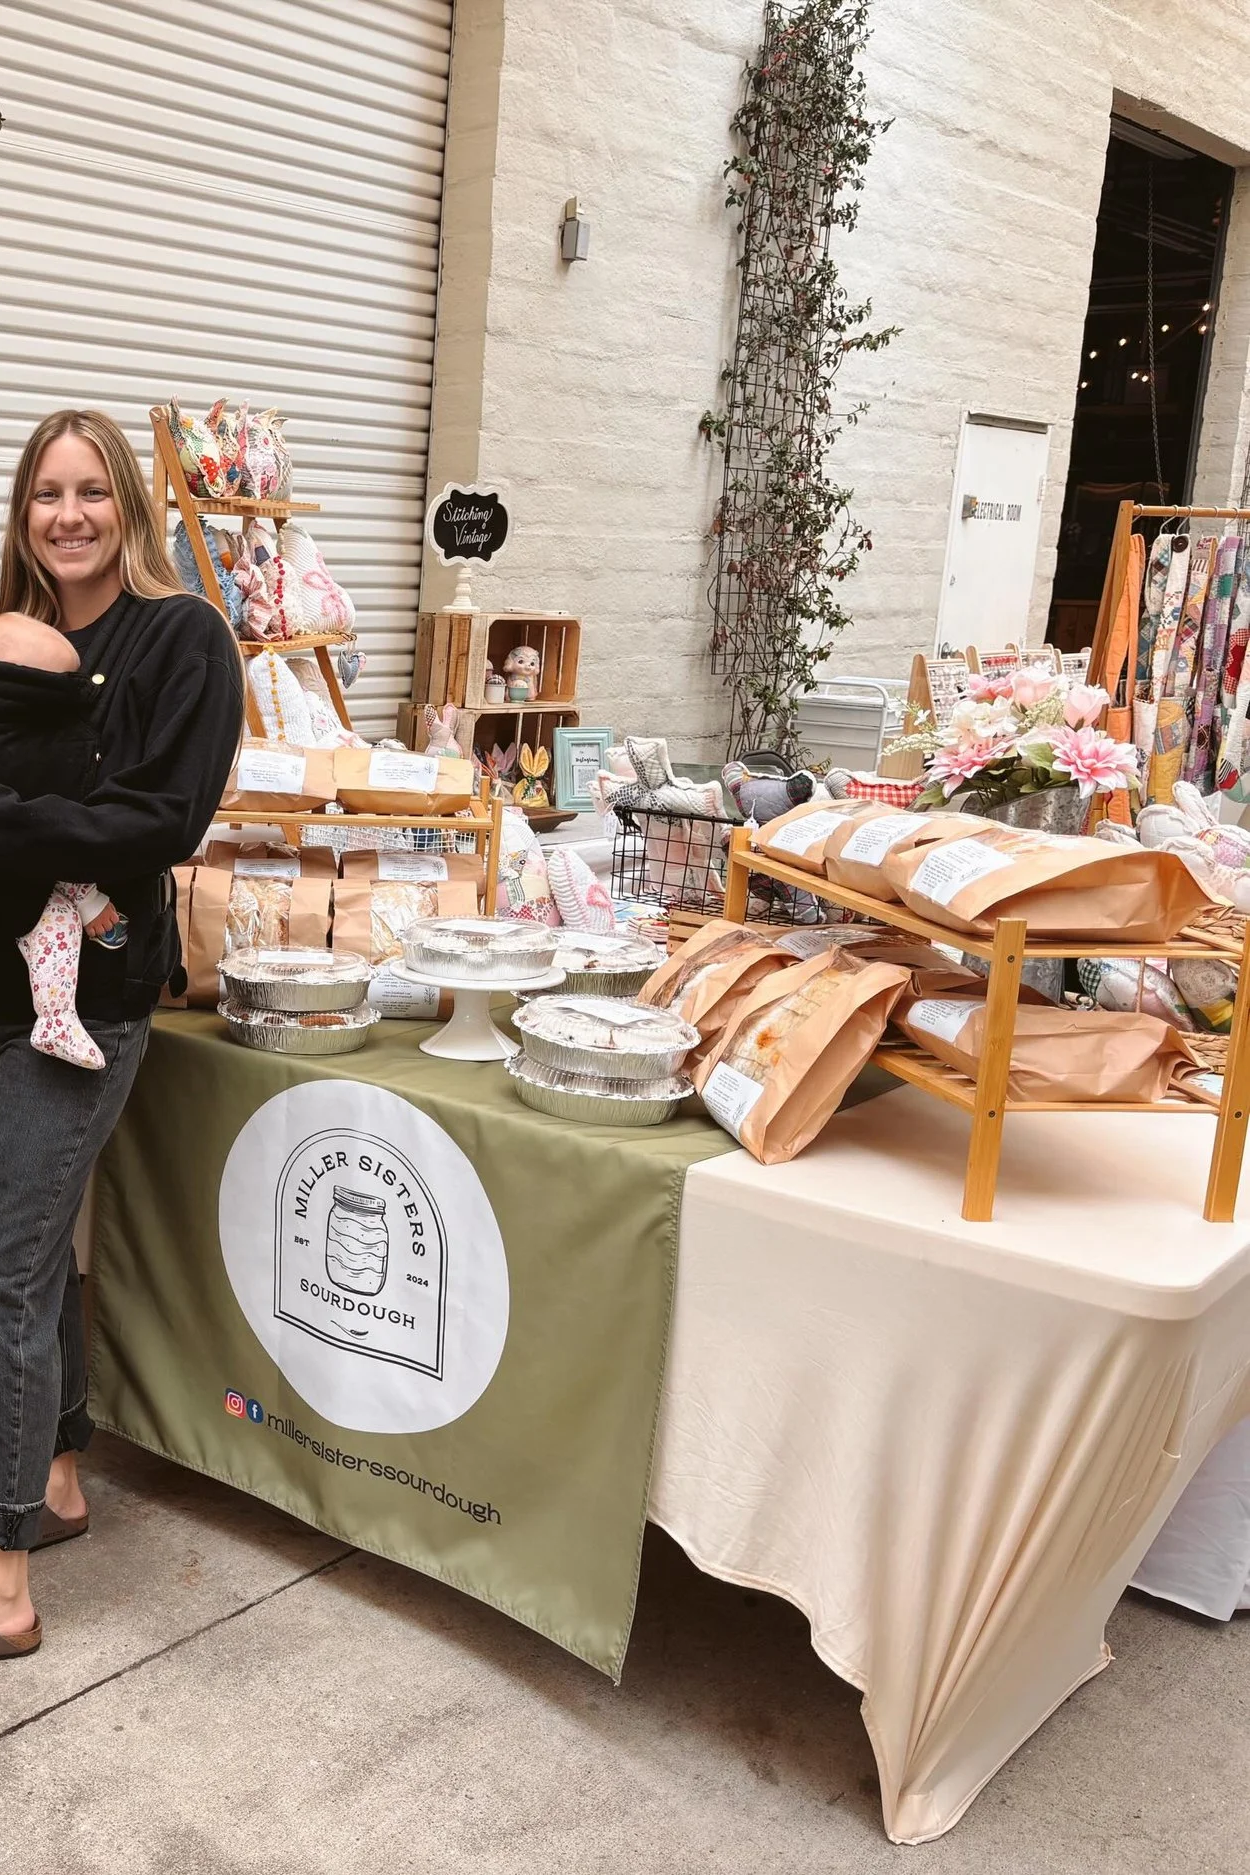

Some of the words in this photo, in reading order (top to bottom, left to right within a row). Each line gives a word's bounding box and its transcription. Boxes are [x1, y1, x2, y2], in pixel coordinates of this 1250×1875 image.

[442, 501, 493, 529] Stitching
[1006, 503, 1022, 521] ROOM
[453, 523, 492, 551] Vintage
[294, 1151, 349, 1219] MILLER
[358, 1155, 427, 1257] SISTERS
[294, 1235, 310, 1247] EST
[406, 1273, 429, 1288] 2024
[300, 1278, 416, 1330] SOURDOUGH
[267, 1412, 502, 1526] millersisterssourdough
